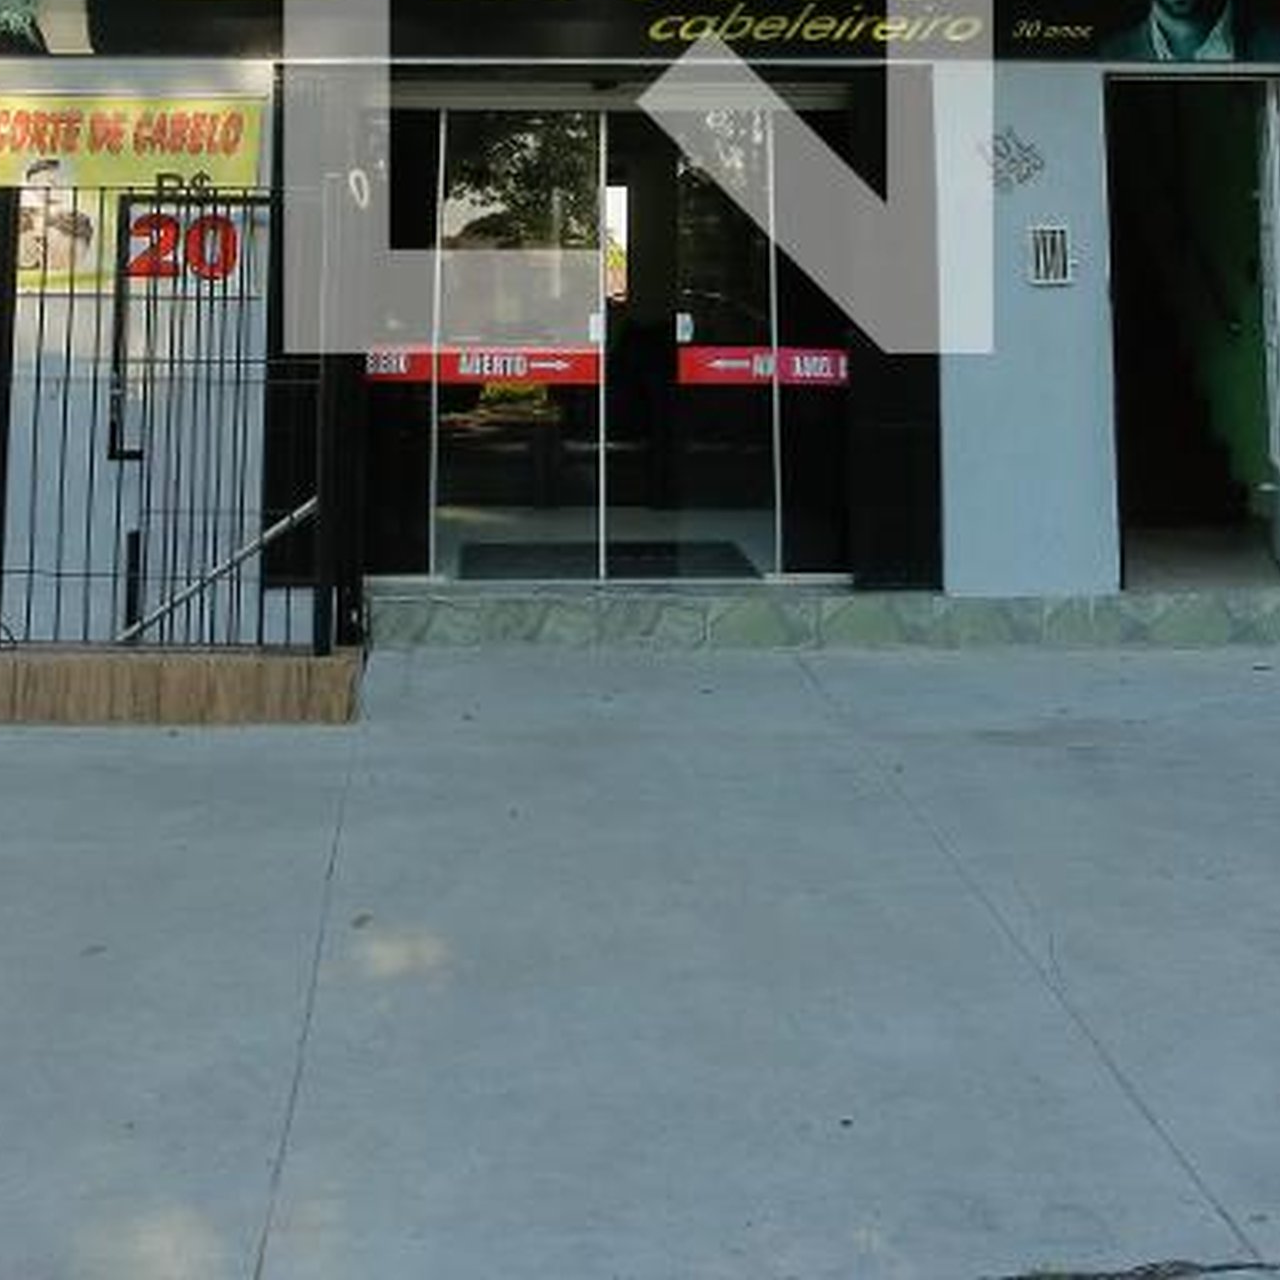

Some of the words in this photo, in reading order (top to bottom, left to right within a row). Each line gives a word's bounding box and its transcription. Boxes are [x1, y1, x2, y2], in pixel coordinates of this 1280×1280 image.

[648, 2, 983, 42] cabeleireiro
[89, 110, 126, 155] DE
[132, 107, 246, 157] CABELO
[126, 213, 238, 281] 20
